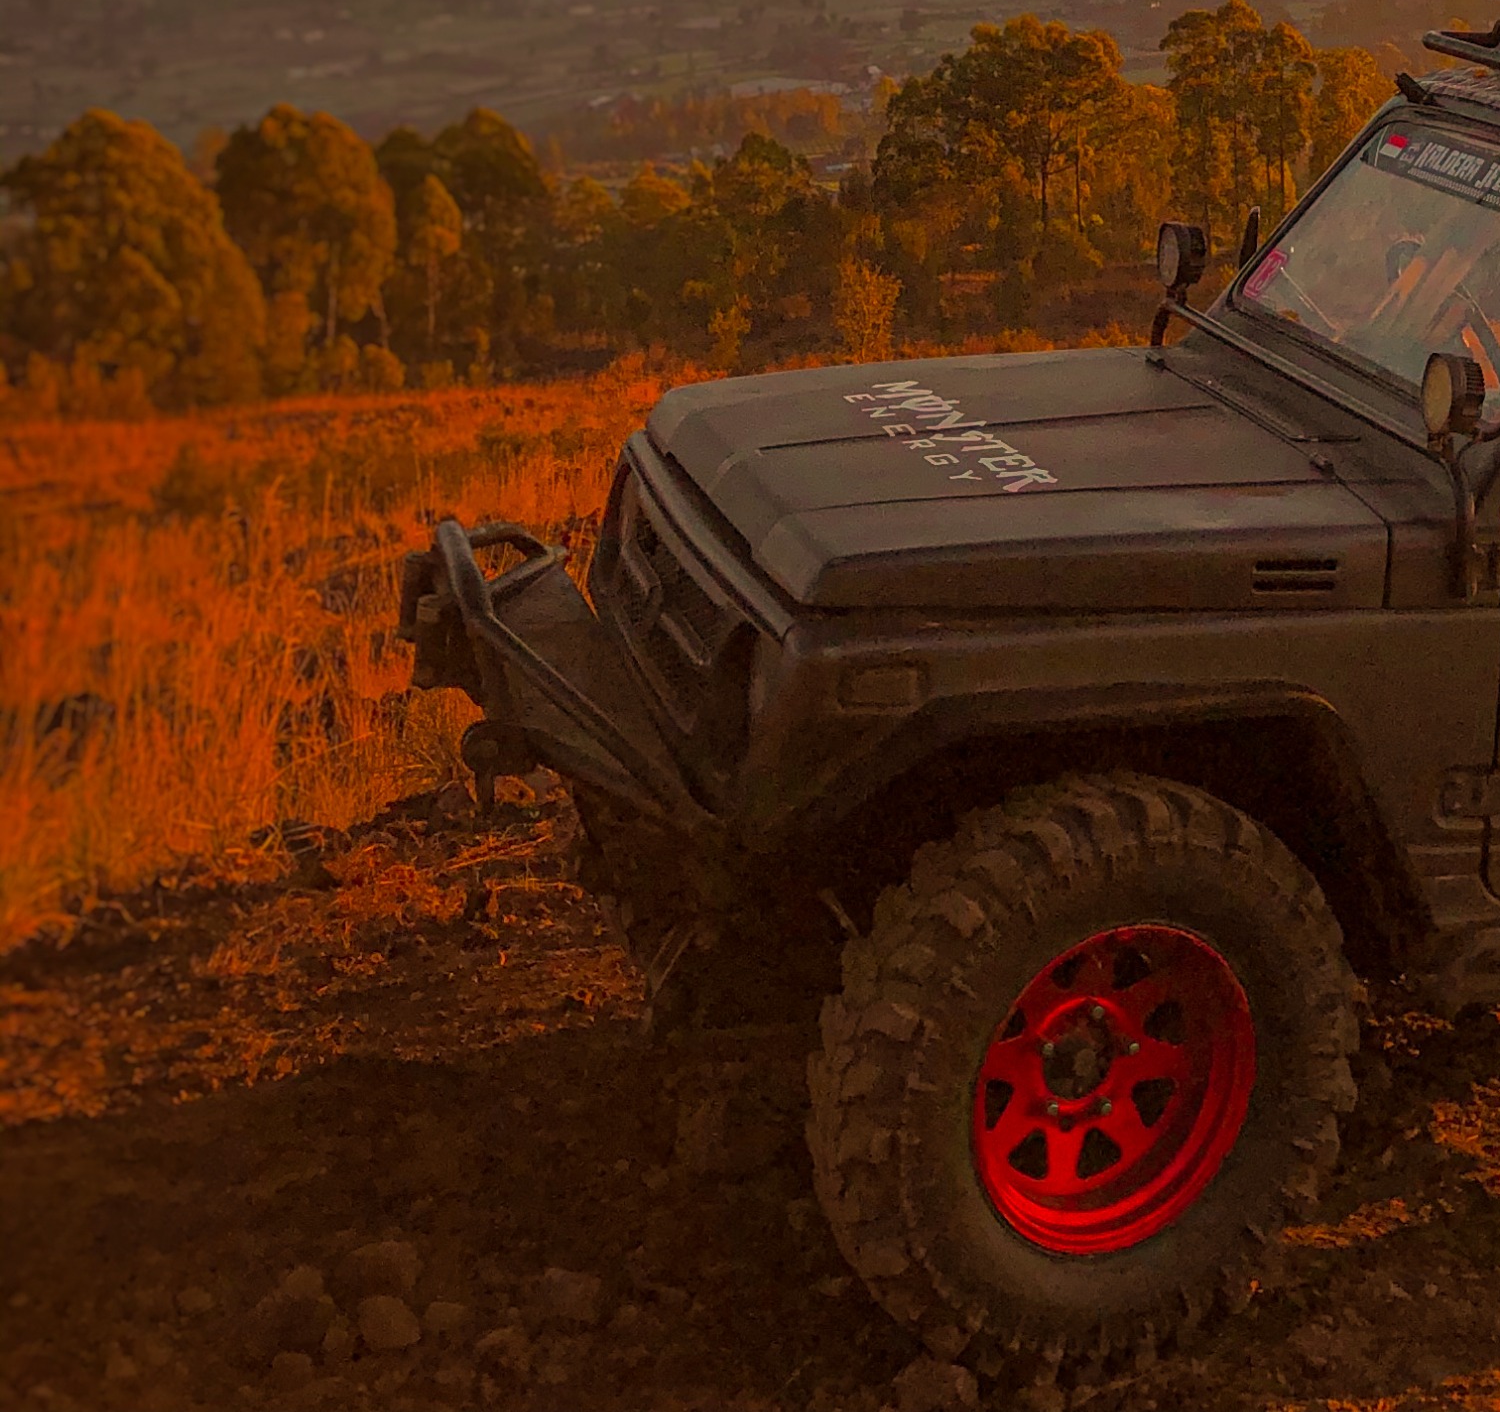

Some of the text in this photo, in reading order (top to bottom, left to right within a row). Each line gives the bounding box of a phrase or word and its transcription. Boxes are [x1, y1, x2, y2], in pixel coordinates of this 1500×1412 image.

[1414, 142, 1485, 180] KALDERA
[844, 393, 982, 481] ENERGY
[872, 380, 1058, 492] MONSTER
